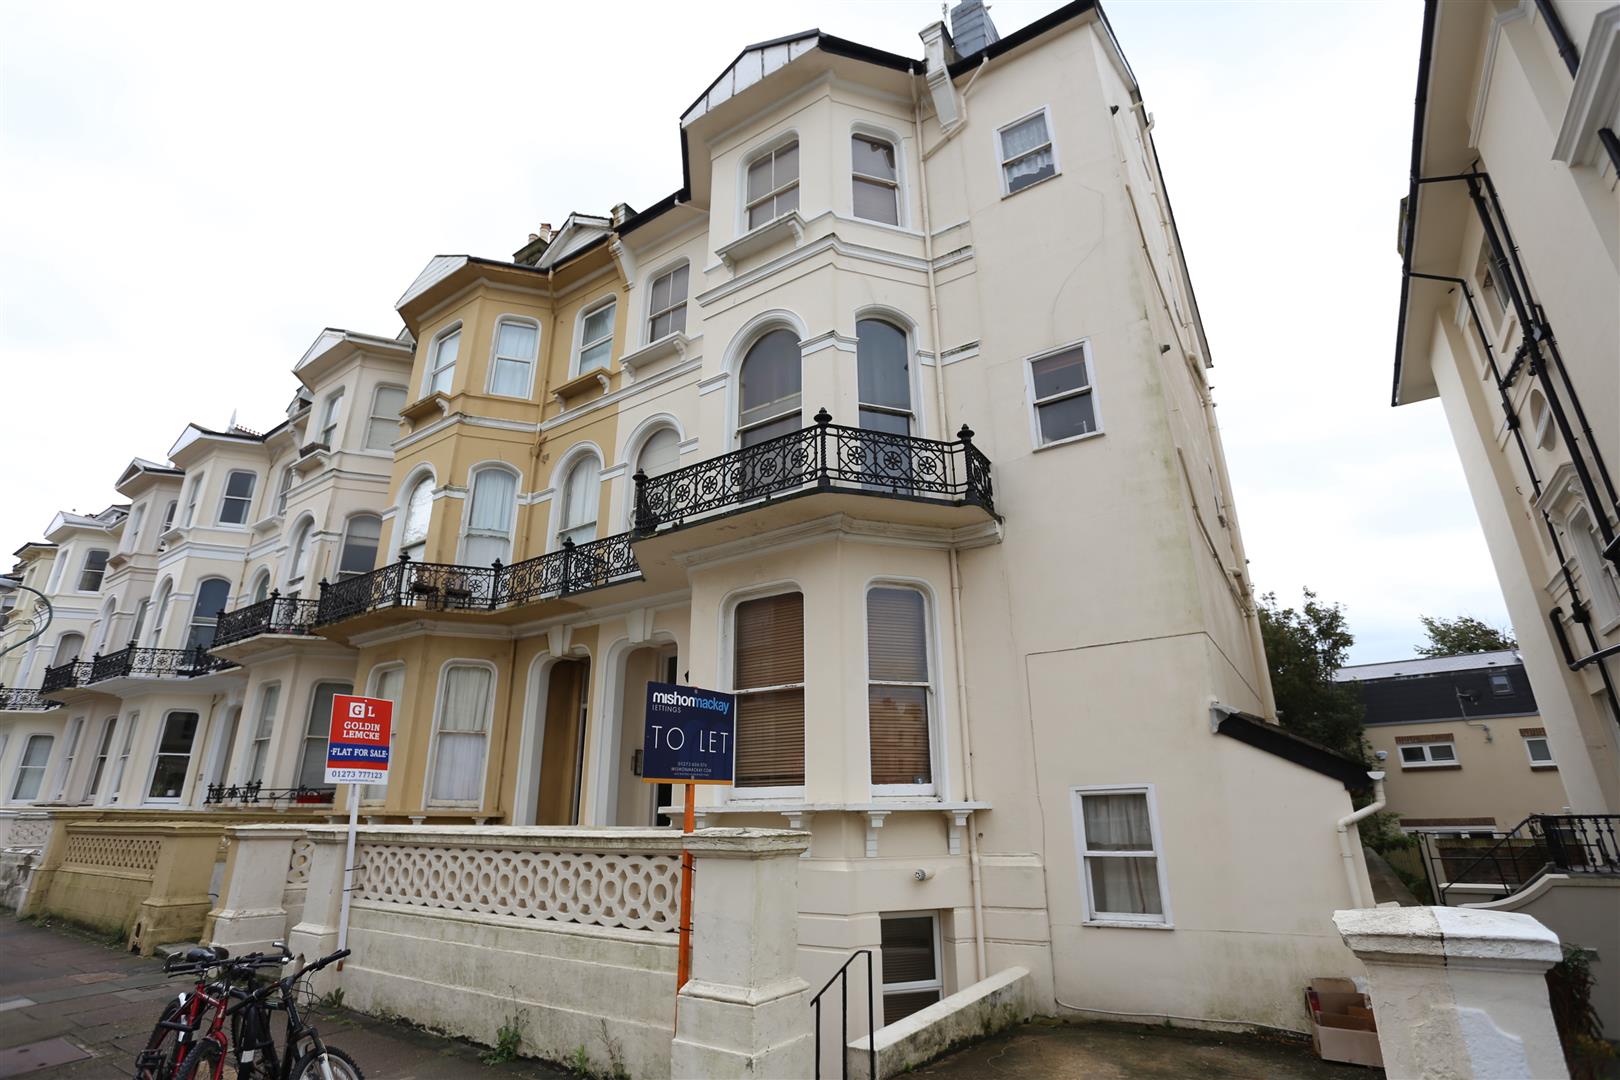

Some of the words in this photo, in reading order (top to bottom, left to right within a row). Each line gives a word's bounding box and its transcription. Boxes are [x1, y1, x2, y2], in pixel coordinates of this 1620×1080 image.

[352, 704, 362, 716] G
[367, 706, 375, 717] L
[344, 721, 380, 731] GOLDIN
[343, 730, 380, 740] LEMCKE
[651, 725, 685, 751] TO
[699, 729, 729, 754] LET
[332, 748, 352, 756] FLAT
[354, 749, 368, 757] FOR
[370, 749, 386, 758] SALE
[331, 770, 356, 778] 01273
[358, 771, 383, 779] 777123
